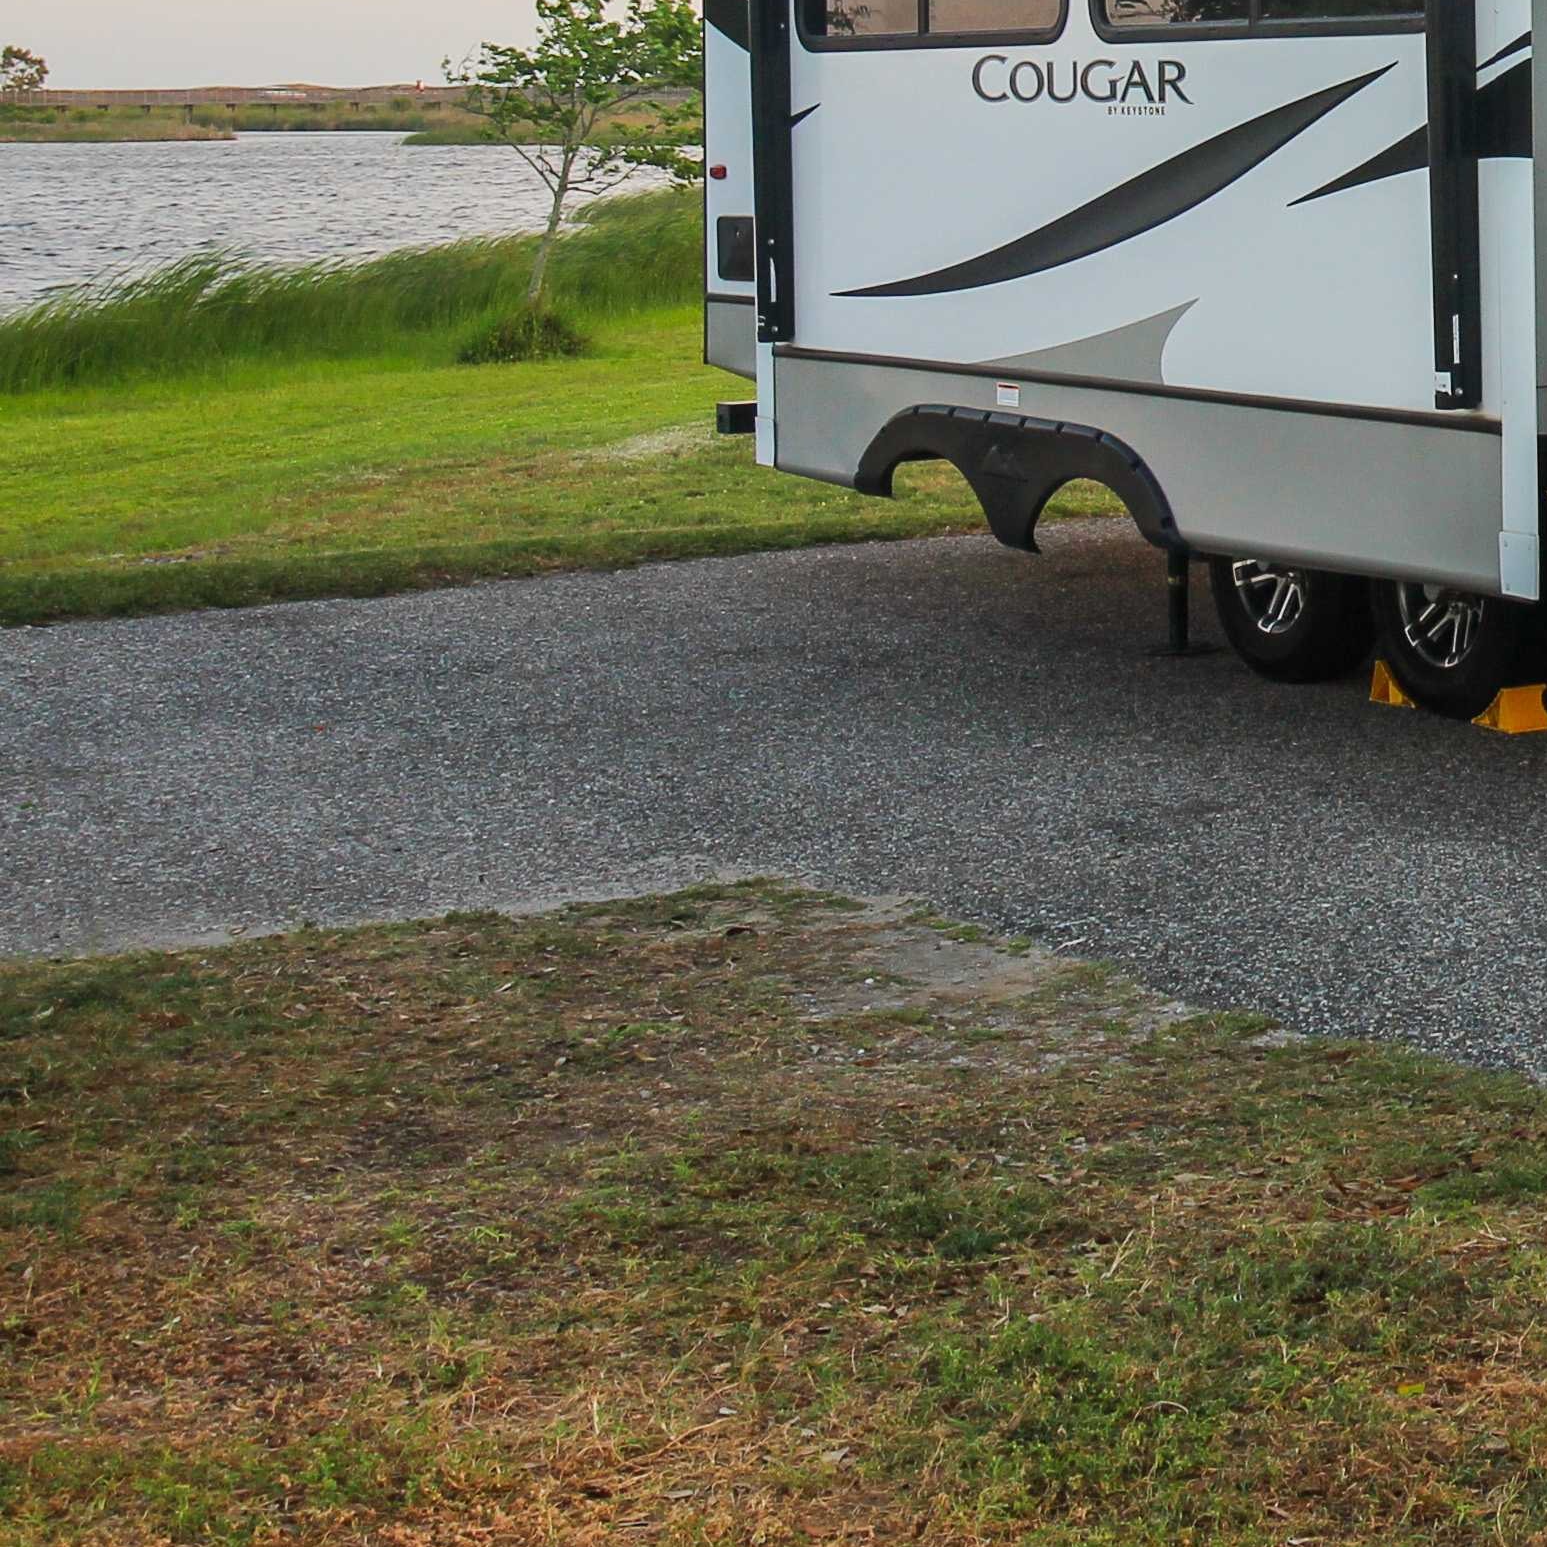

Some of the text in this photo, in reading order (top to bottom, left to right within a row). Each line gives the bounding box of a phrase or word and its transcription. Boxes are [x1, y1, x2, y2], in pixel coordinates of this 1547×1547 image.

[972, 54, 1194, 105] COUGAR
[1107, 105, 1166, 116] BY KEYSTONE
